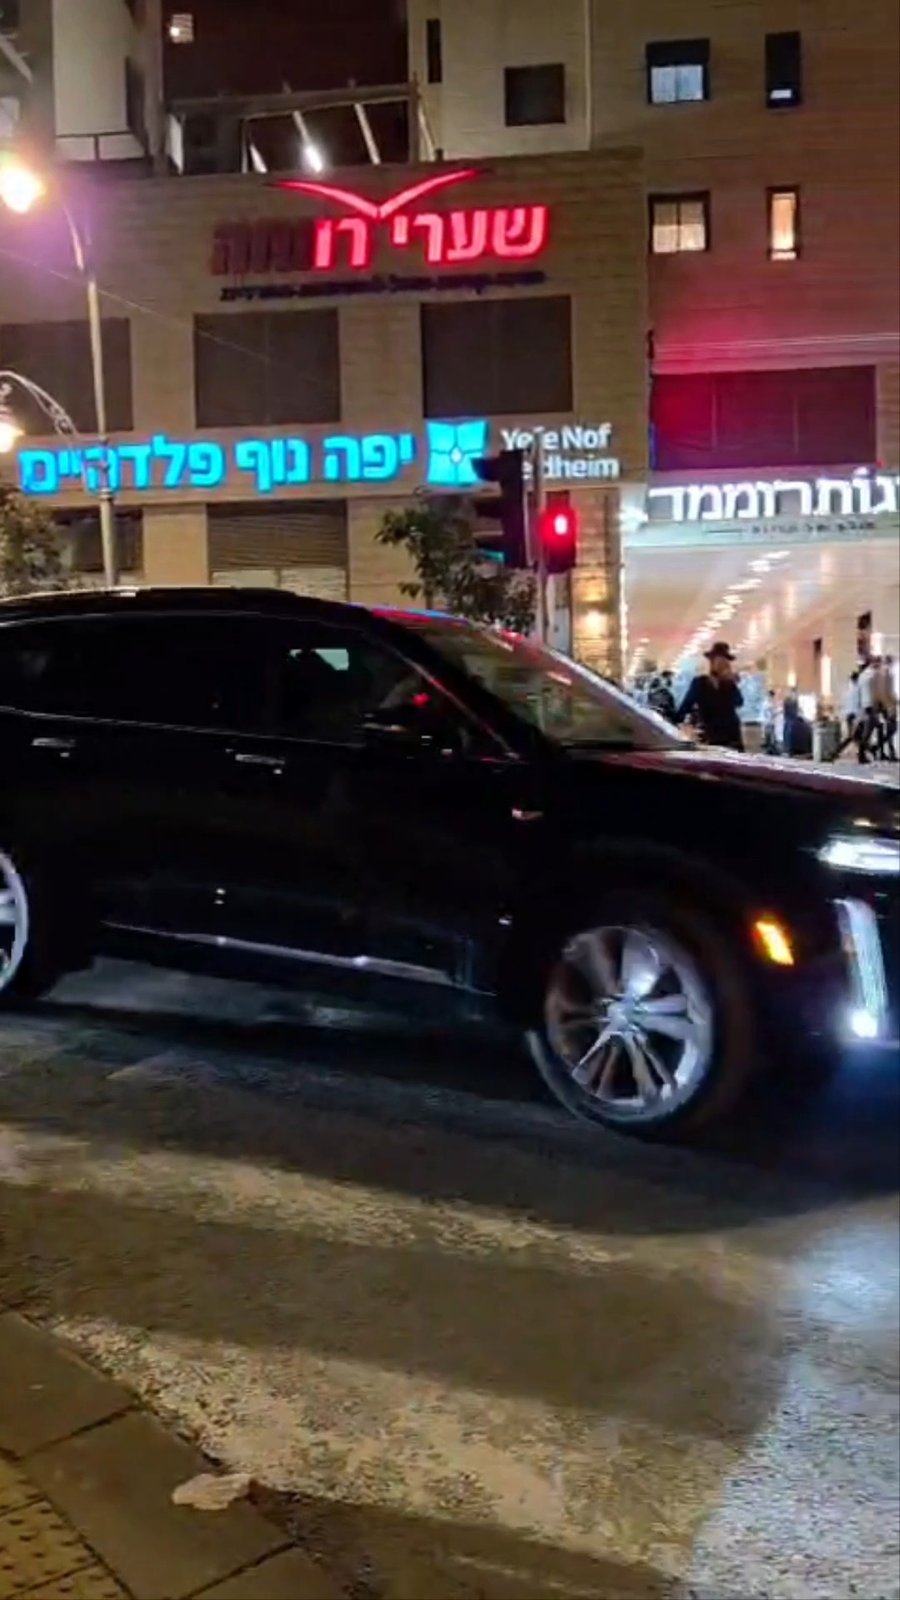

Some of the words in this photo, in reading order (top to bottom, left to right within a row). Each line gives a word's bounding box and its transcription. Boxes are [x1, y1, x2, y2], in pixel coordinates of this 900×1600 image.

[391, 204, 548, 264] שערי
[17, 434, 225, 493] פלדהיים
[323, 432, 417, 482] יפה
[560, 422, 612, 449] Nof
[235, 436, 308, 493] נוף
